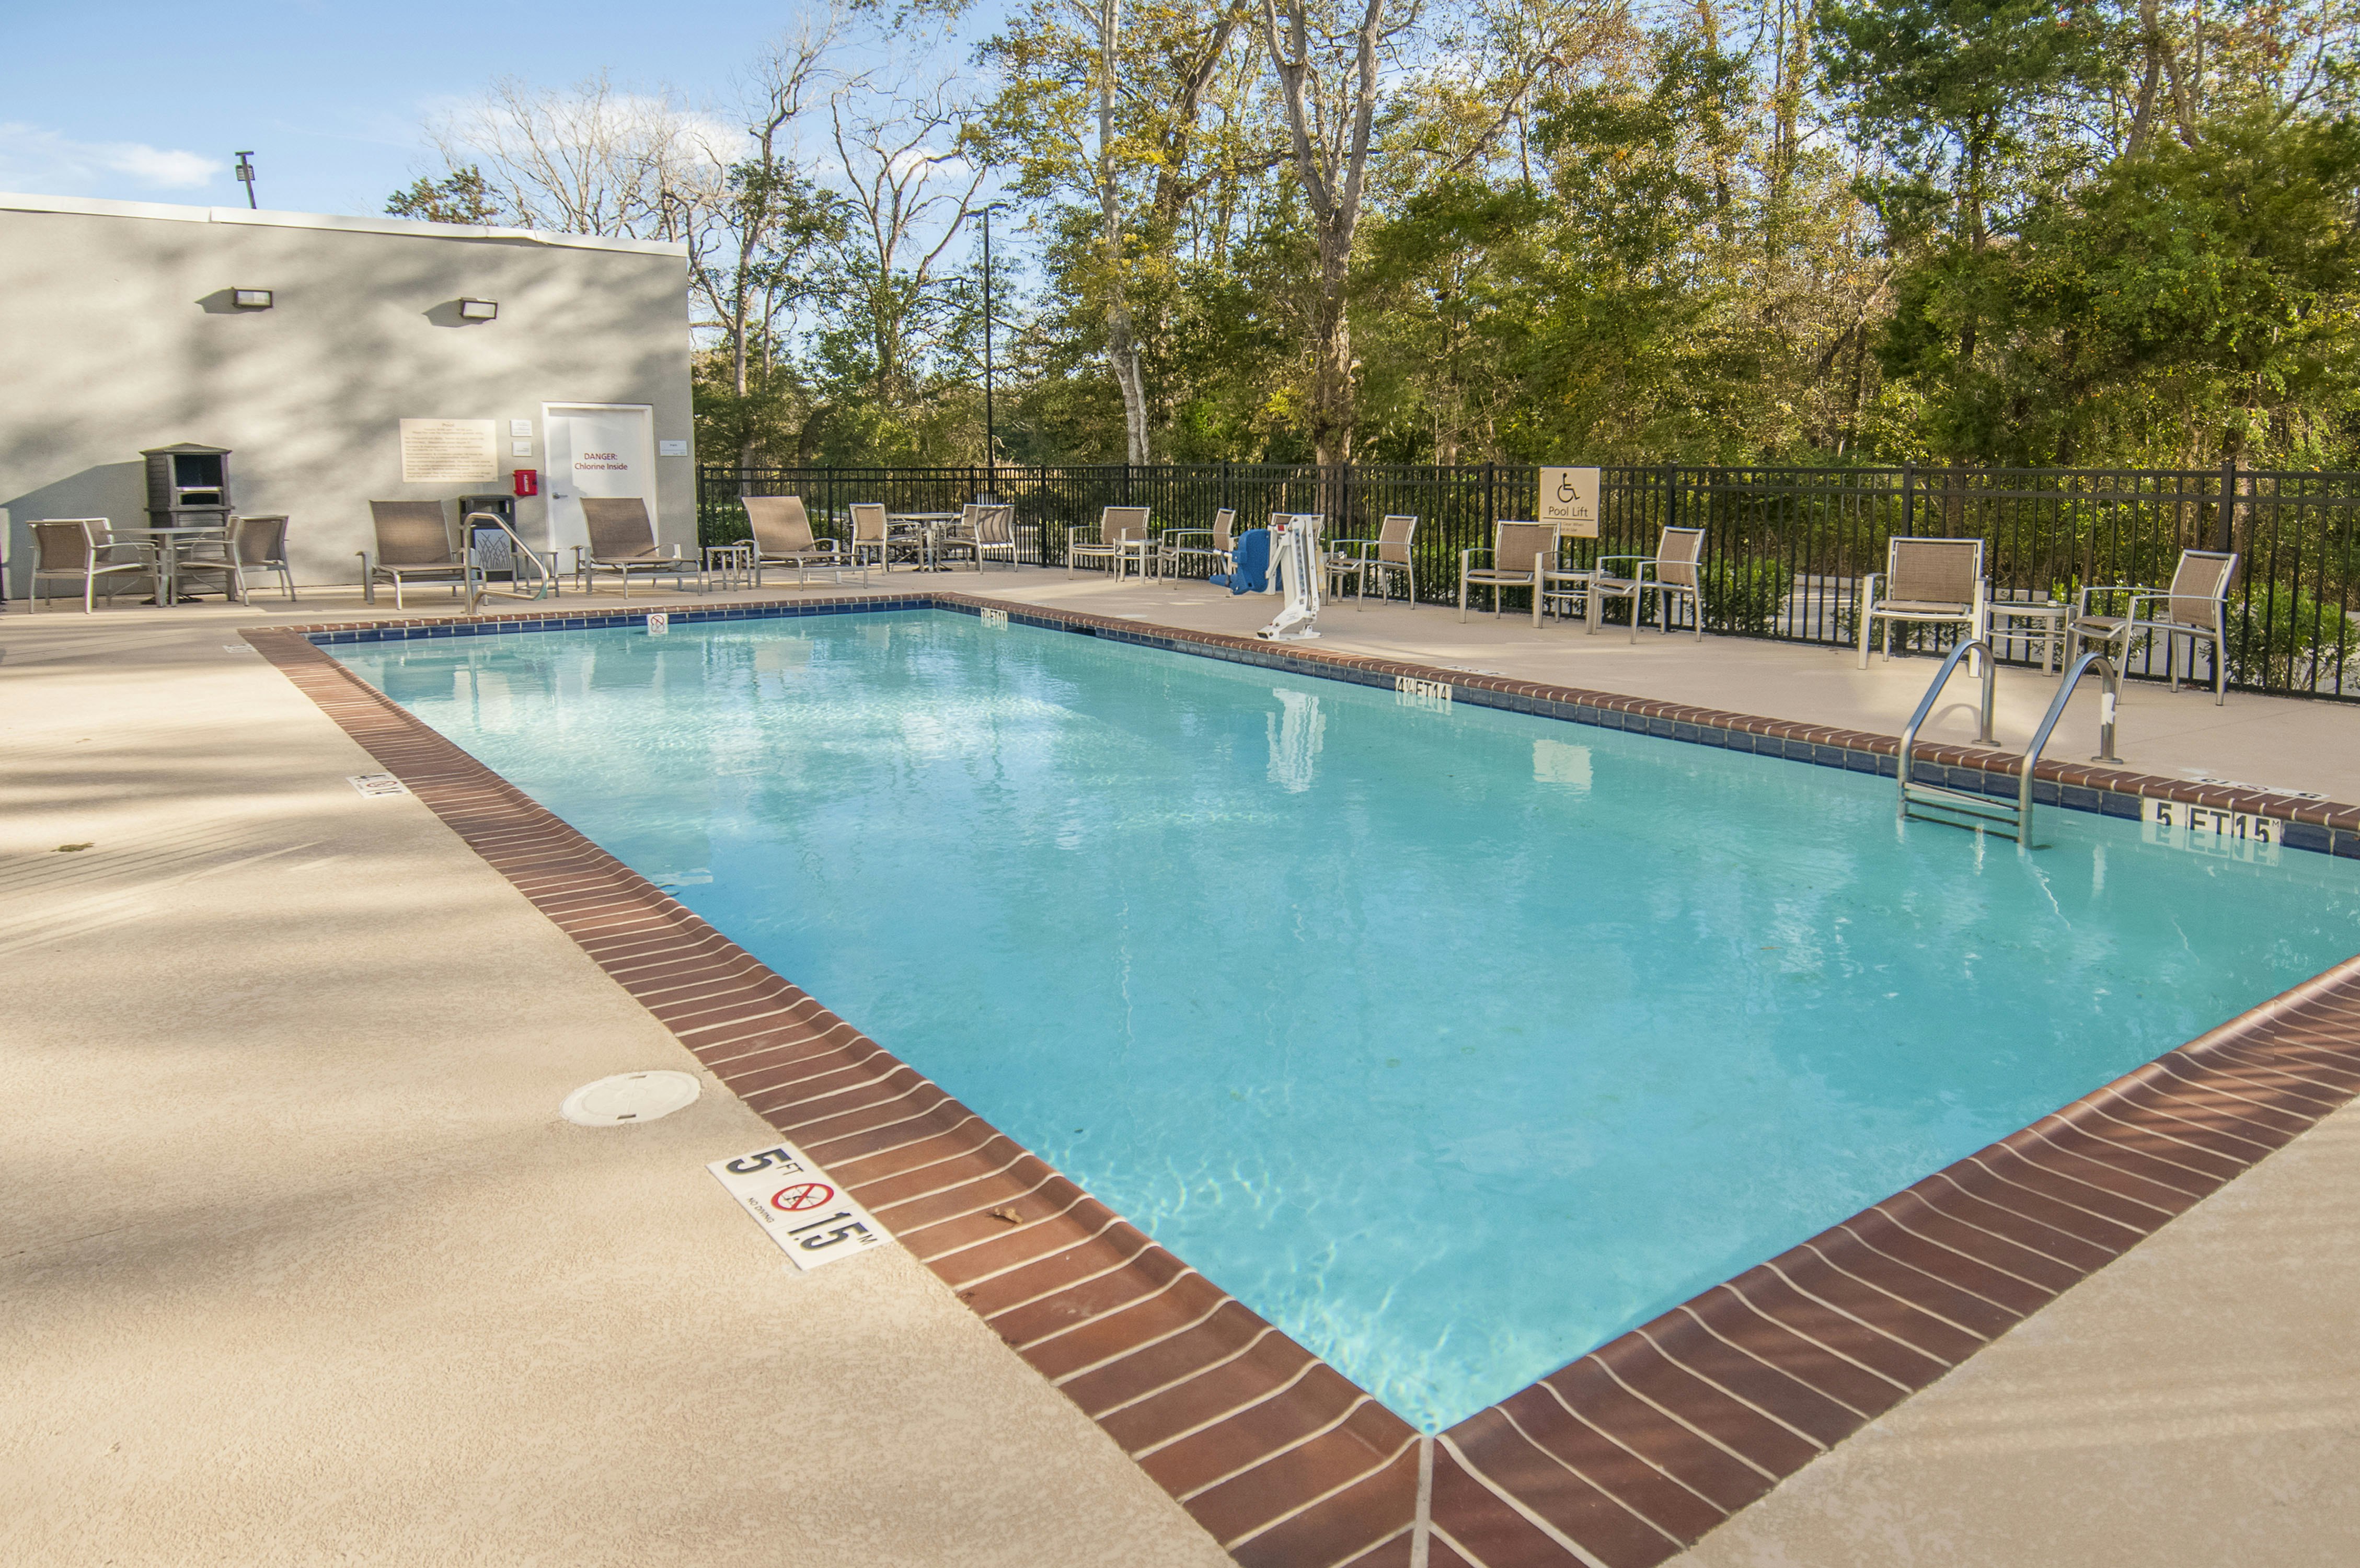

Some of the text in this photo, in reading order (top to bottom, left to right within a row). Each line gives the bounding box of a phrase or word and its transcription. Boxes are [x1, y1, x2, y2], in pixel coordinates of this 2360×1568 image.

[1549, 506, 1588, 517] Pool Lift
[1415, 681, 1432, 697] FT
[2157, 802, 2172, 826] 5
[2190, 808, 2230, 835] FT
[725, 1148, 804, 1175] 5 FT
[746, 1197, 775, 1223] NO DIVING
[857, 1233, 878, 1246] M
